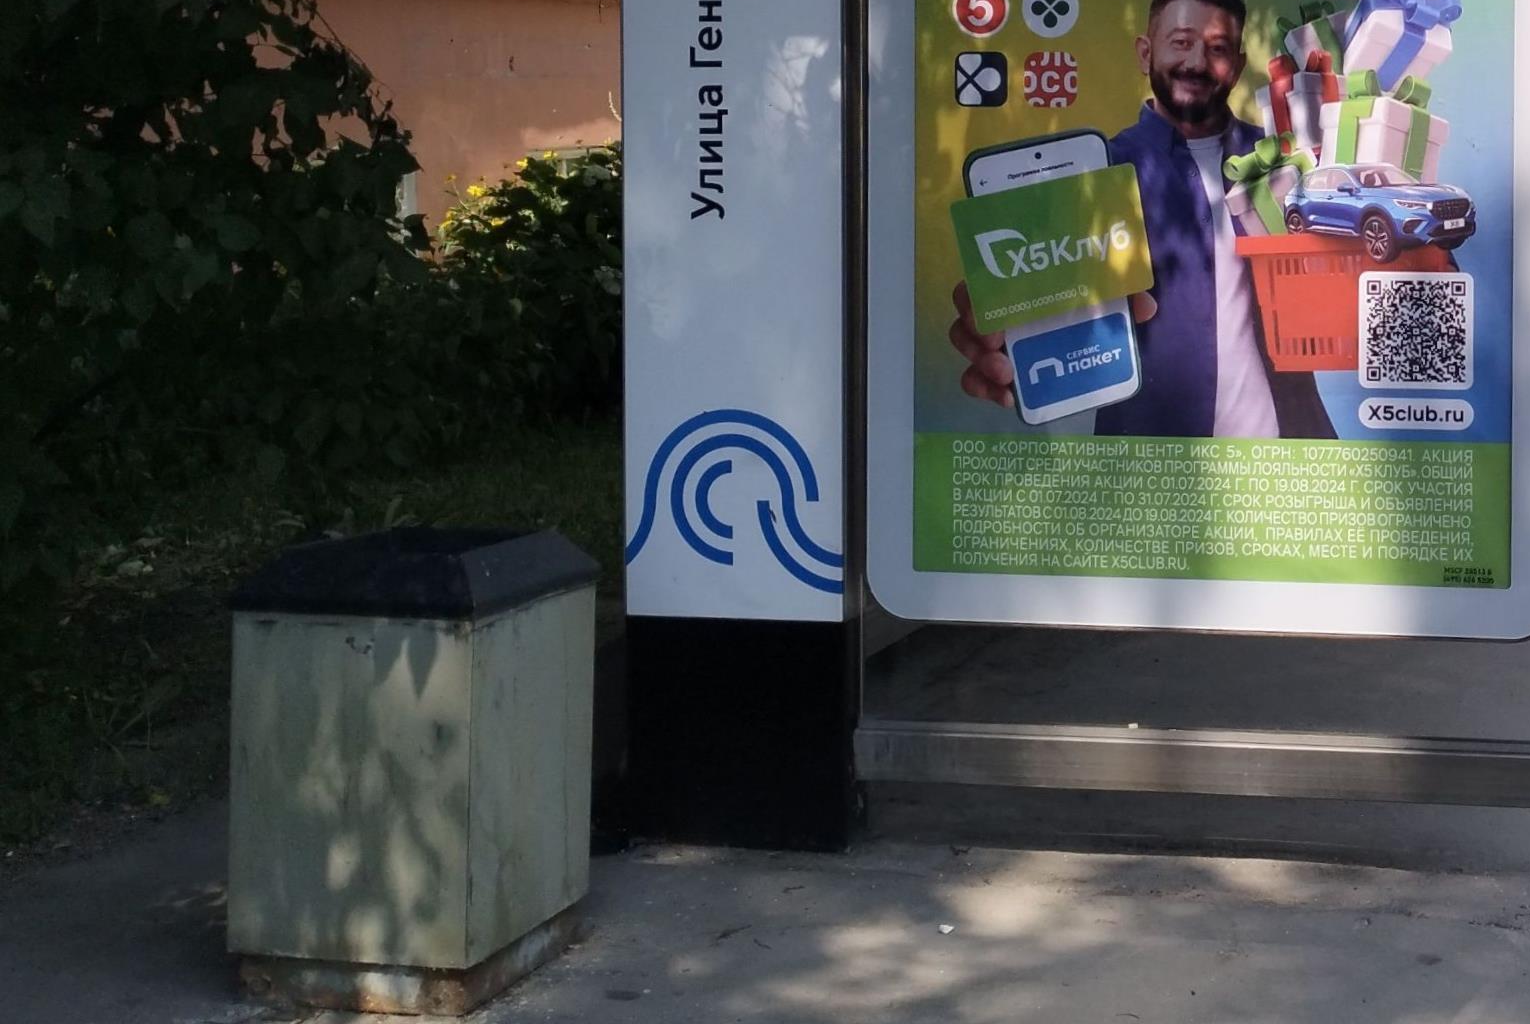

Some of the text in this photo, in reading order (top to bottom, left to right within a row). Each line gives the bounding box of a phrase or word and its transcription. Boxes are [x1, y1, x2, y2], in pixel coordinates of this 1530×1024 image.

[690, 84, 727, 220] Улица
[1066, 344, 1100, 360] СЕРВИС
[1068, 348, 1122, 374] пакет
[1368, 405, 1464, 422] X5club.ru
[953, 440, 985, 454] ООО
[992, 441, 1129, 457] «КОРПОРАТИВНЫЙ
[1135, 445, 1184, 458] ЦЕНТР
[1190, 445, 1220, 458] ИКС
[1226, 446, 1246, 460] 5»,
[1251, 445, 1296, 460] ОГРН:
[1422, 449, 1473, 464] АКЦИЯ
[953, 456, 1024, 472] ПРОХОДИТ
[1026, 458, 1071, 473] СРЕДИ
[1074, 459, 1162, 473] УЧАСТНИКОВ
[1165, 460, 1250, 475] ПРОГРАММЫ
[1253, 462, 1347, 476] ЛОЯЛЬНОСТИ
[1421, 462, 1473, 480] ОБЩИЙ
[953, 472, 1473, 497] СРОК ПРОВЕДЕНИЯ АКЦИИ С 01.07.2024 Г. ПО 19.08.2024 Г. СРОК УЧАСТИЯ
[953, 488, 1473, 512] В АКЦИИ С 01.07.2024 Г. ПО 31.07.2024 Г. СРОК РОЗЫГРЫША И ОБЪЯВЛЕНИЯ
[953, 504, 1041, 518] РЕЗУЛЬТАТОВ
[1043, 507, 1052, 520] С
[1054, 507, 1121, 521] 01.08.2024
[1123, 508, 1142, 523] ДО
[1144, 509, 1211, 523] 19.08.2024
[1227, 510, 1317, 525] КОЛИЧЕСТВО
[1320, 512, 1376, 527] ПРИЗОВ
[953, 520, 1474, 546] ПОДРОБНОСТИ ОБ ОРГАНИЗАТОРЕ АКЦИИ, ПРАВИЛАХ ЕЁ ПРОВЕДЕНИЯ,
[953, 536, 1473, 562] ОГРАНИЧЕНИЯХ, КОЛИЧЕСТВЕ ПРИЗОВ, СРОКАХ, МЕСТЕ И ПОРЯДКЕ ИХ
[953, 552, 1190, 570] ПОЛУЧЕНИЯ НА САЙТЕ X5CLUB.RU.
